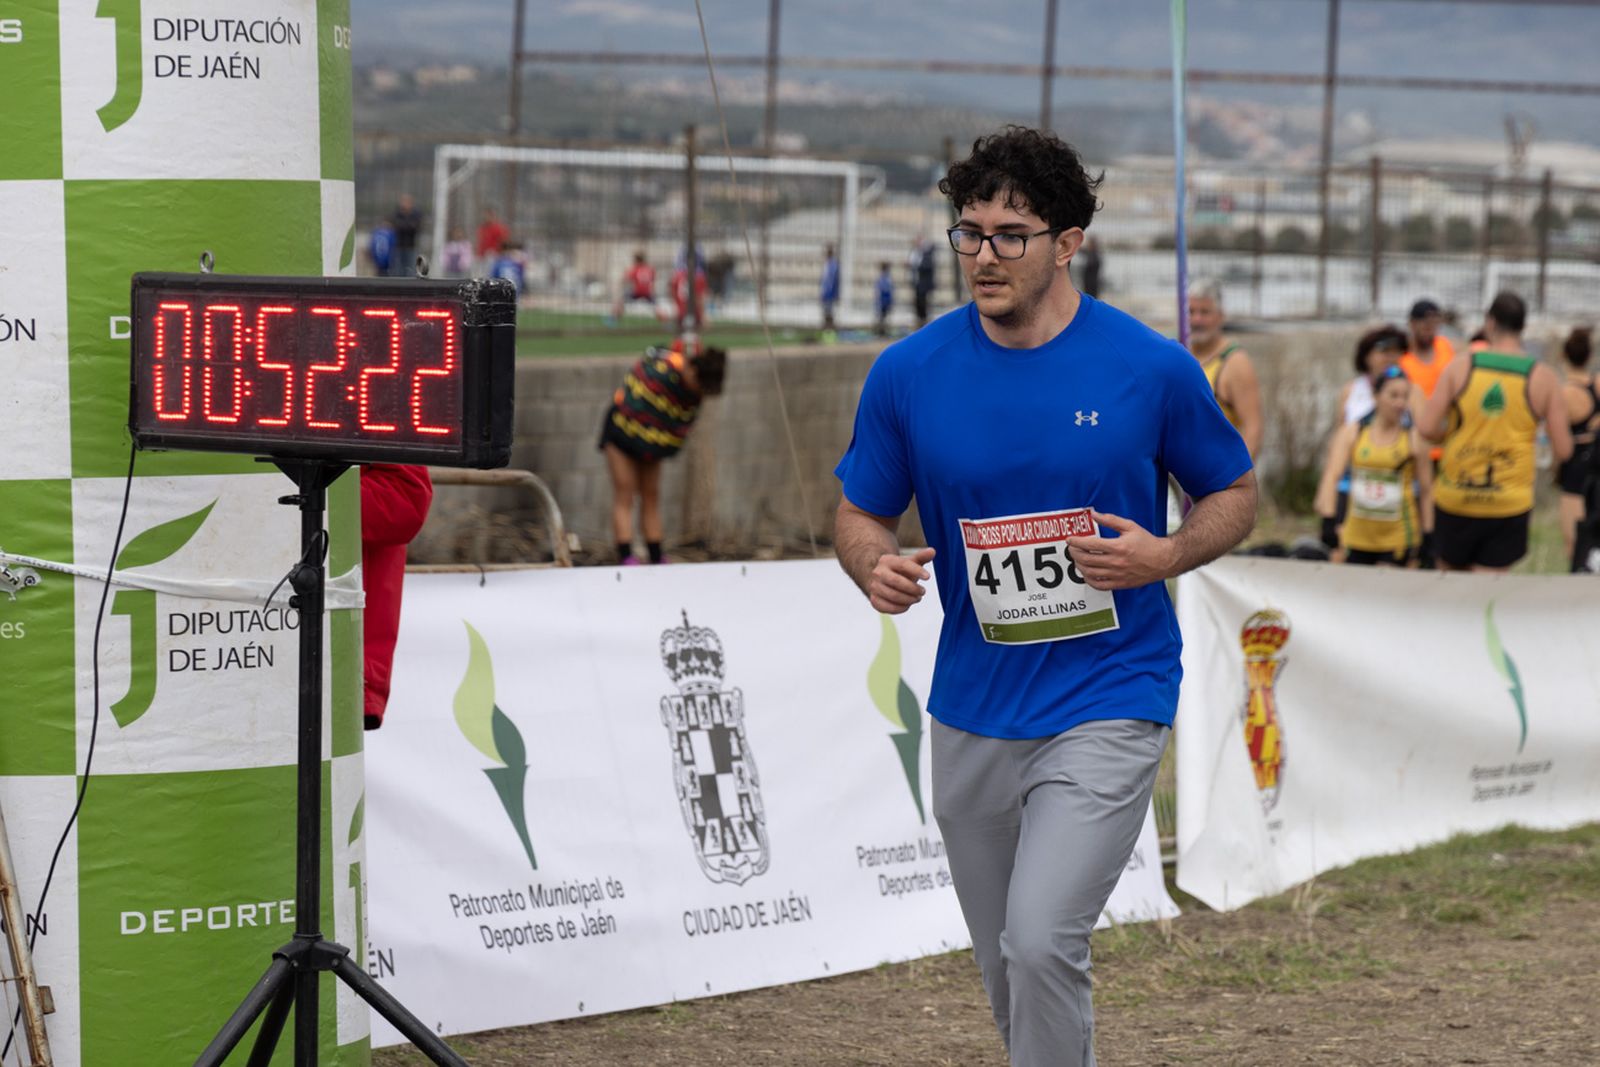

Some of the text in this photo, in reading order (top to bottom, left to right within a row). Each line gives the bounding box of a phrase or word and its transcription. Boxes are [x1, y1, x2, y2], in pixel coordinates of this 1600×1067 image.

[153, 17, 301, 45] DIPUTACIÓN
[154, 52, 260, 79] DE JAÉN
[153, 303, 455, 434] 00:52:22
[1001, 520, 1034, 543] POPULAR
[1033, 519, 1060, 540] CIUDAD
[1060, 517, 1072, 536] DE
[996, 599, 1087, 620] JODAR LLINAS
[1027, 592, 1048, 602] JOSE
[169, 641, 274, 672] DE JAÉN
[856, 841, 917, 868] Patronato
[449, 876, 625, 918] Patronato Municipal de
[878, 871, 934, 900] Deportes
[682, 889, 813, 938] CIUDAD DE JAÉN
[479, 909, 618, 954] Deportes de Jaén
